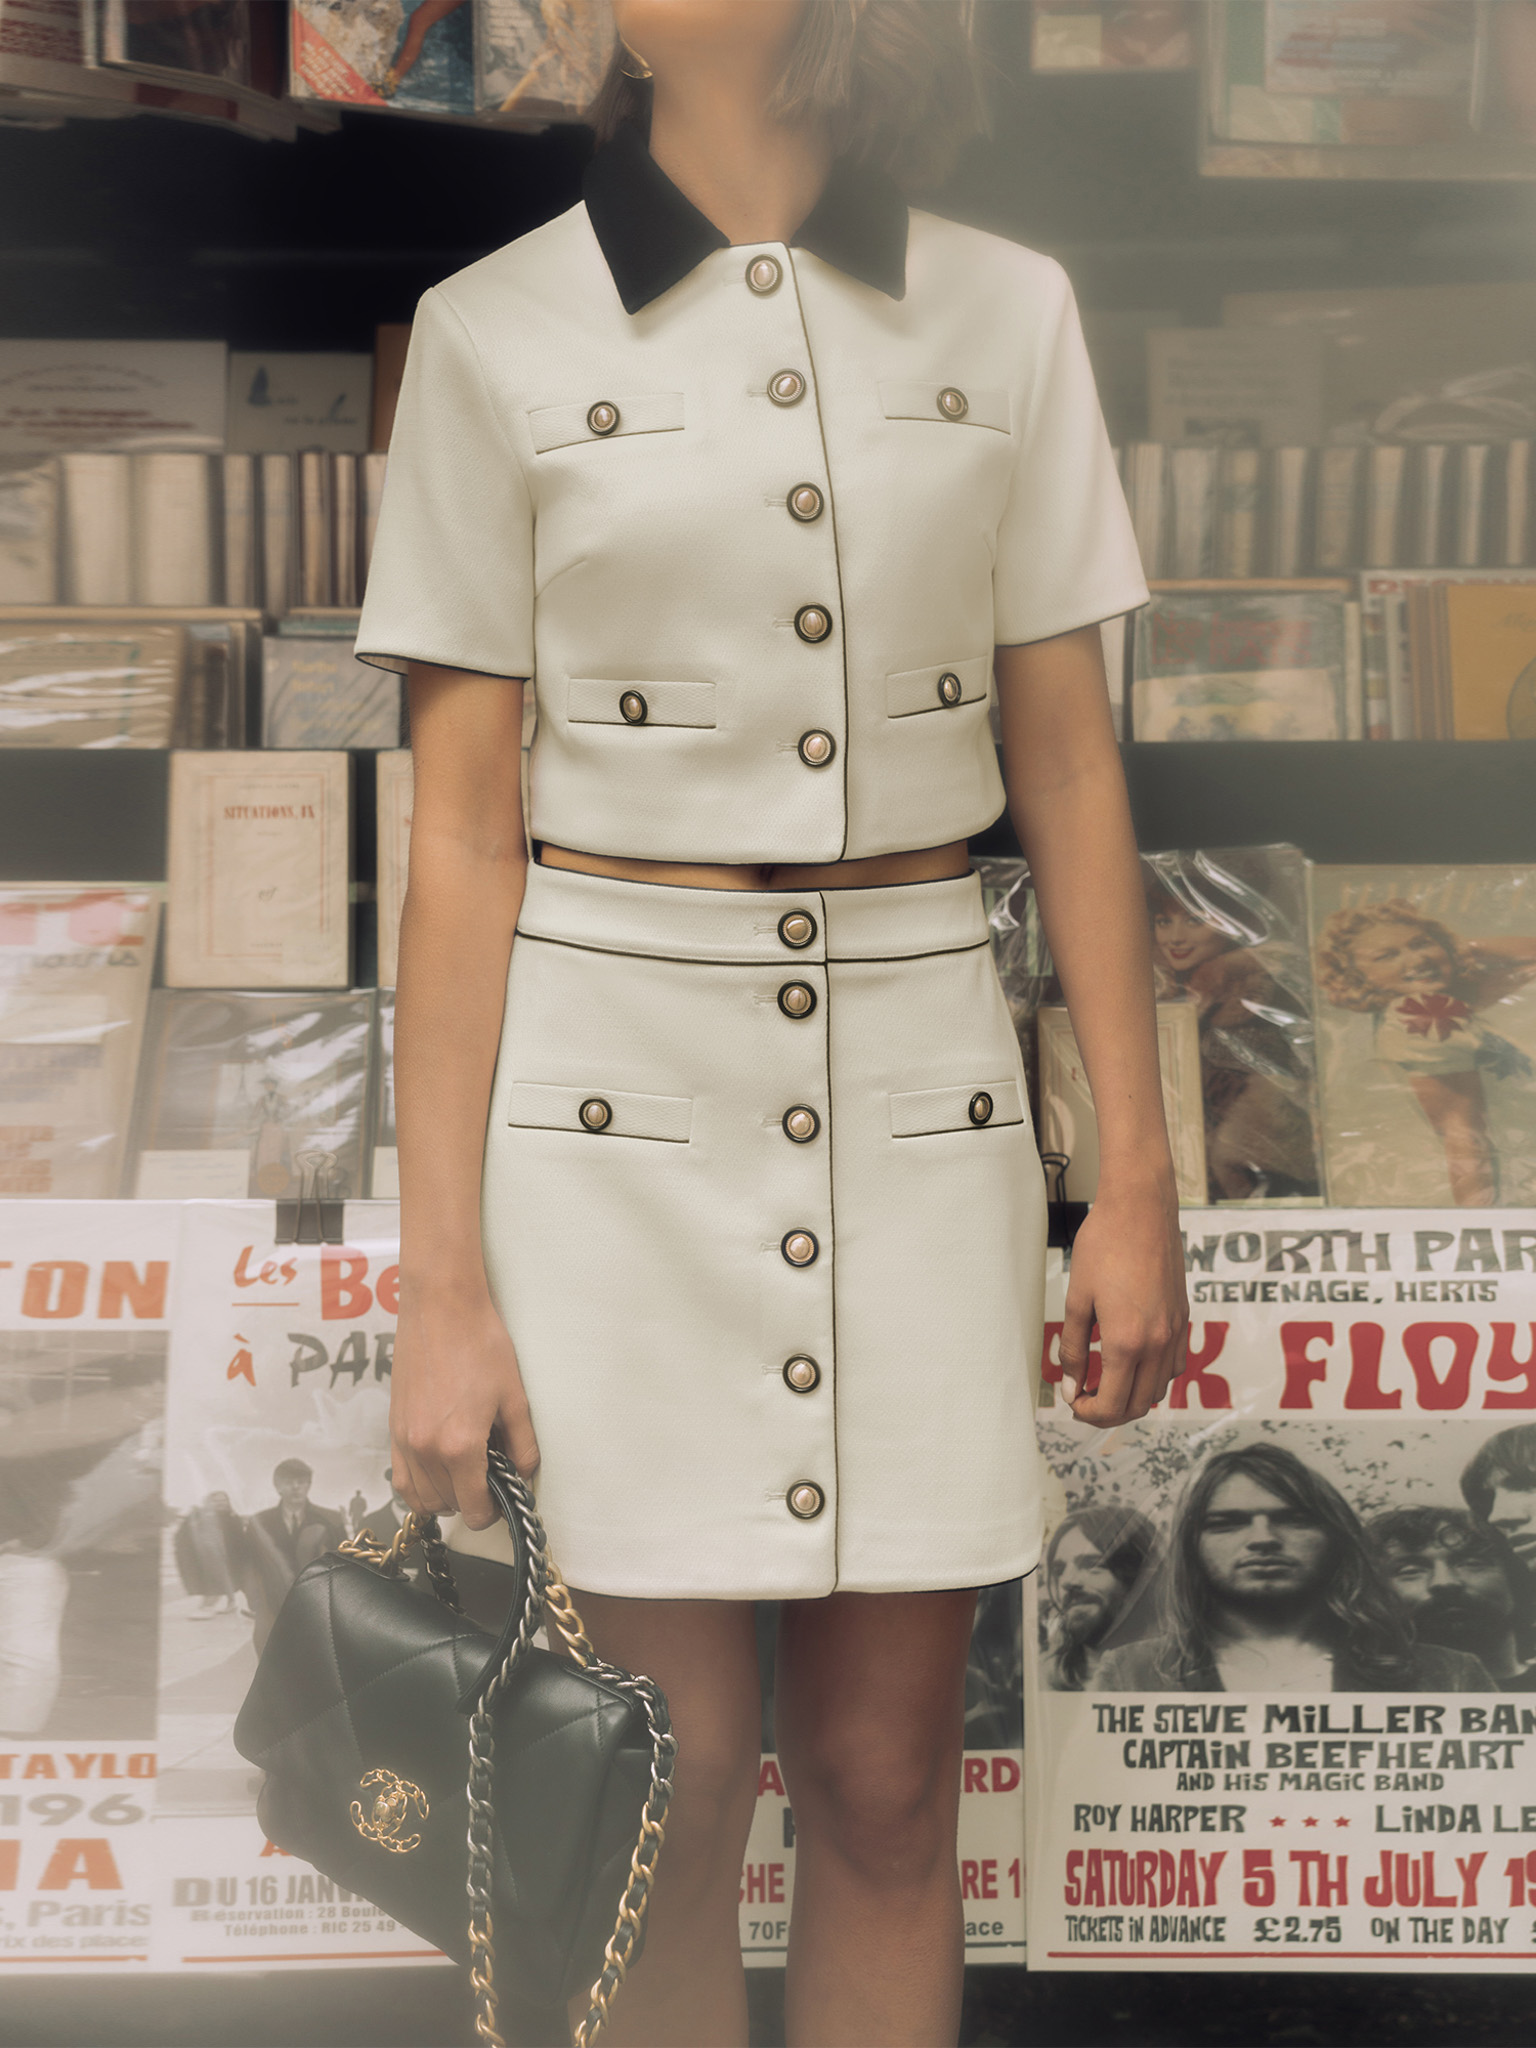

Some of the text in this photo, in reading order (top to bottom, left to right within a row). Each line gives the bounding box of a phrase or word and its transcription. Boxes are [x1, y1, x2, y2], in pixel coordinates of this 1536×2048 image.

[234, 1245, 298, 1288] Les
[0, 1261, 170, 1319] ON
[1193, 1280, 1499, 1304] STEVENAGE, HERTS
[1092, 1704, 1144, 1733] THE
[1153, 1704, 1247, 1733] STEVE
[1265, 1740, 1525, 1770] BEEFHEART
[960, 1757, 1021, 1793] RD
[1176, 1772, 1215, 1791] AND
[1374, 1773, 1444, 1791] BAND
[1074, 1804, 1122, 1832] ROY
[1130, 1804, 1247, 1832] HARPER
[173, 1876, 237, 1907] DU
[245, 1875, 278, 1906] 16
[739, 1864, 785, 1903] HE
[1064, 1848, 1228, 1908] SATURDAY
[1242, 1849, 1276, 1907] 5
[1289, 1850, 1349, 1907] TH
[1363, 1850, 1489, 1908] JULY
[27, 1900, 152, 1927] Paris
[352, 1920, 372, 1933] 25
[376, 1918, 396, 1932] 49
[1149, 1915, 1227, 1942] ADVANCE
[1254, 1915, 1342, 1943] £2.75
[1370, 1917, 1400, 1942] ON
[1408, 1917, 1453, 1943] THE
[1461, 1917, 1510, 1944] DAY
